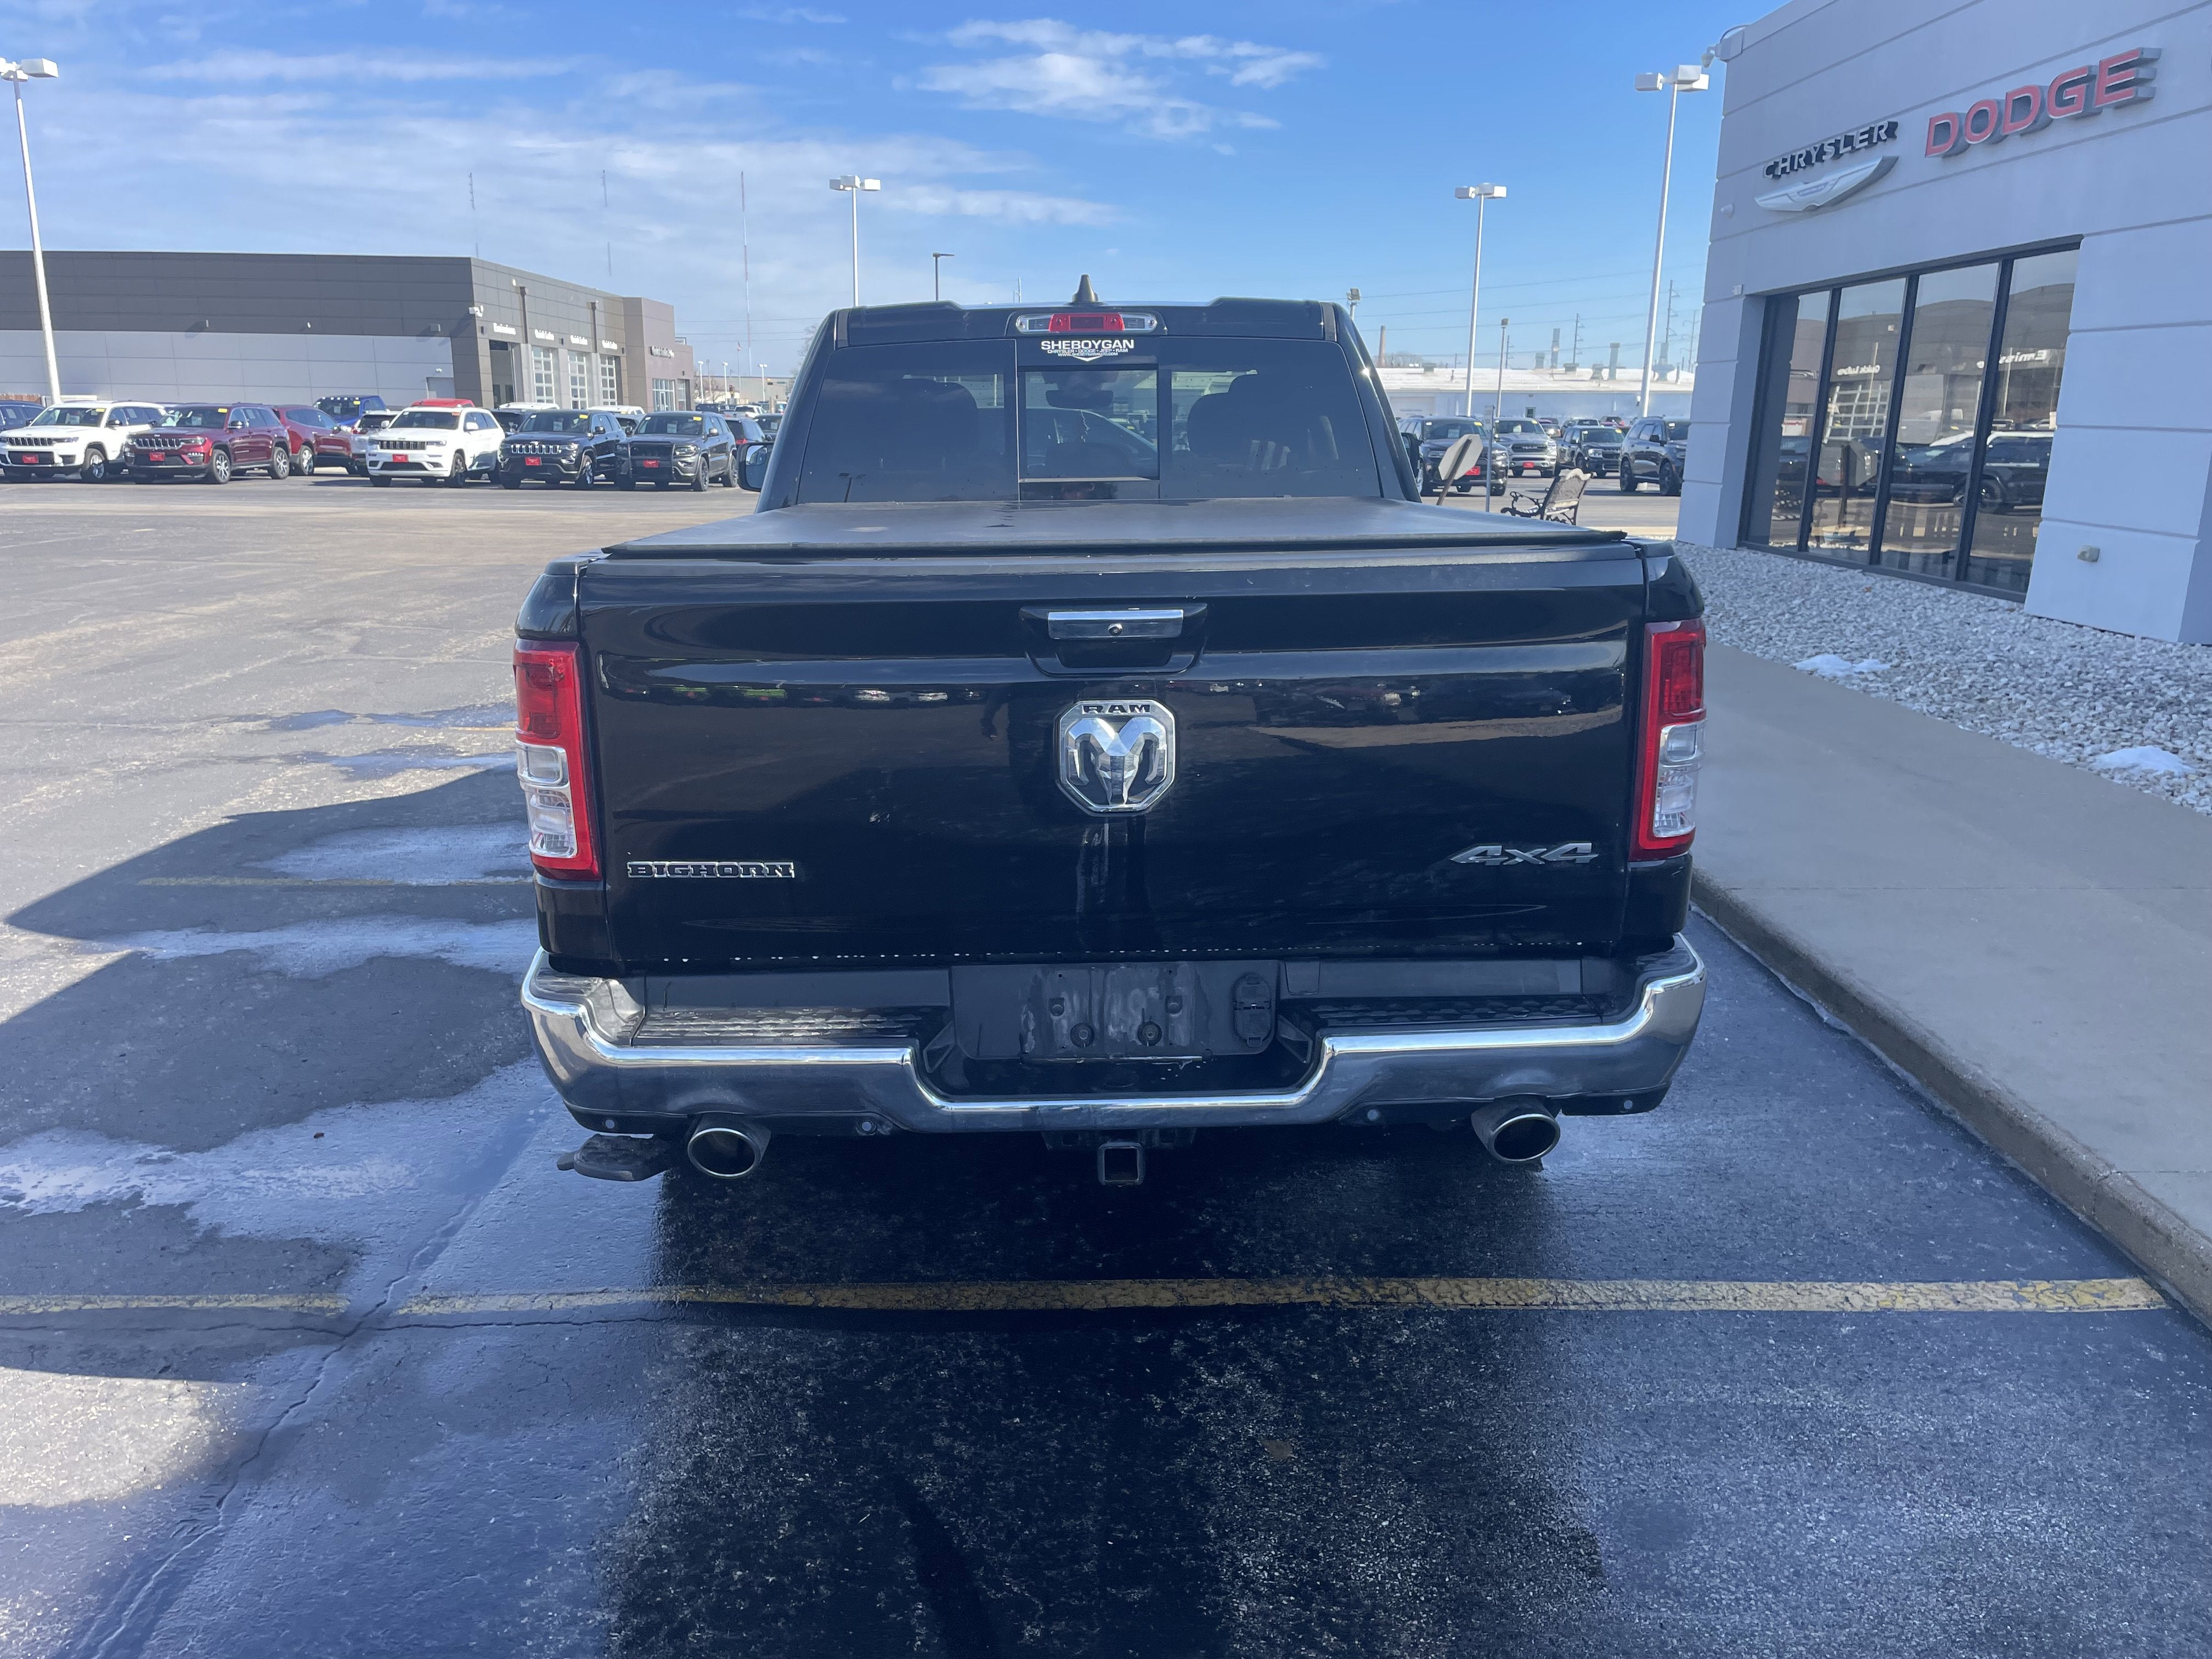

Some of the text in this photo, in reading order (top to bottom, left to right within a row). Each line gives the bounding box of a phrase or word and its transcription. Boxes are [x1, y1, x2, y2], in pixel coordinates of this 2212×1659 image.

[1925, 47, 2148, 158] DODGE
[1763, 120, 1896, 179] CHRYSLER
[1041, 339, 1135, 350] SHEBOYGAN
[1082, 704, 1150, 714] RAM
[627, 861, 795, 878] BIGHORN
